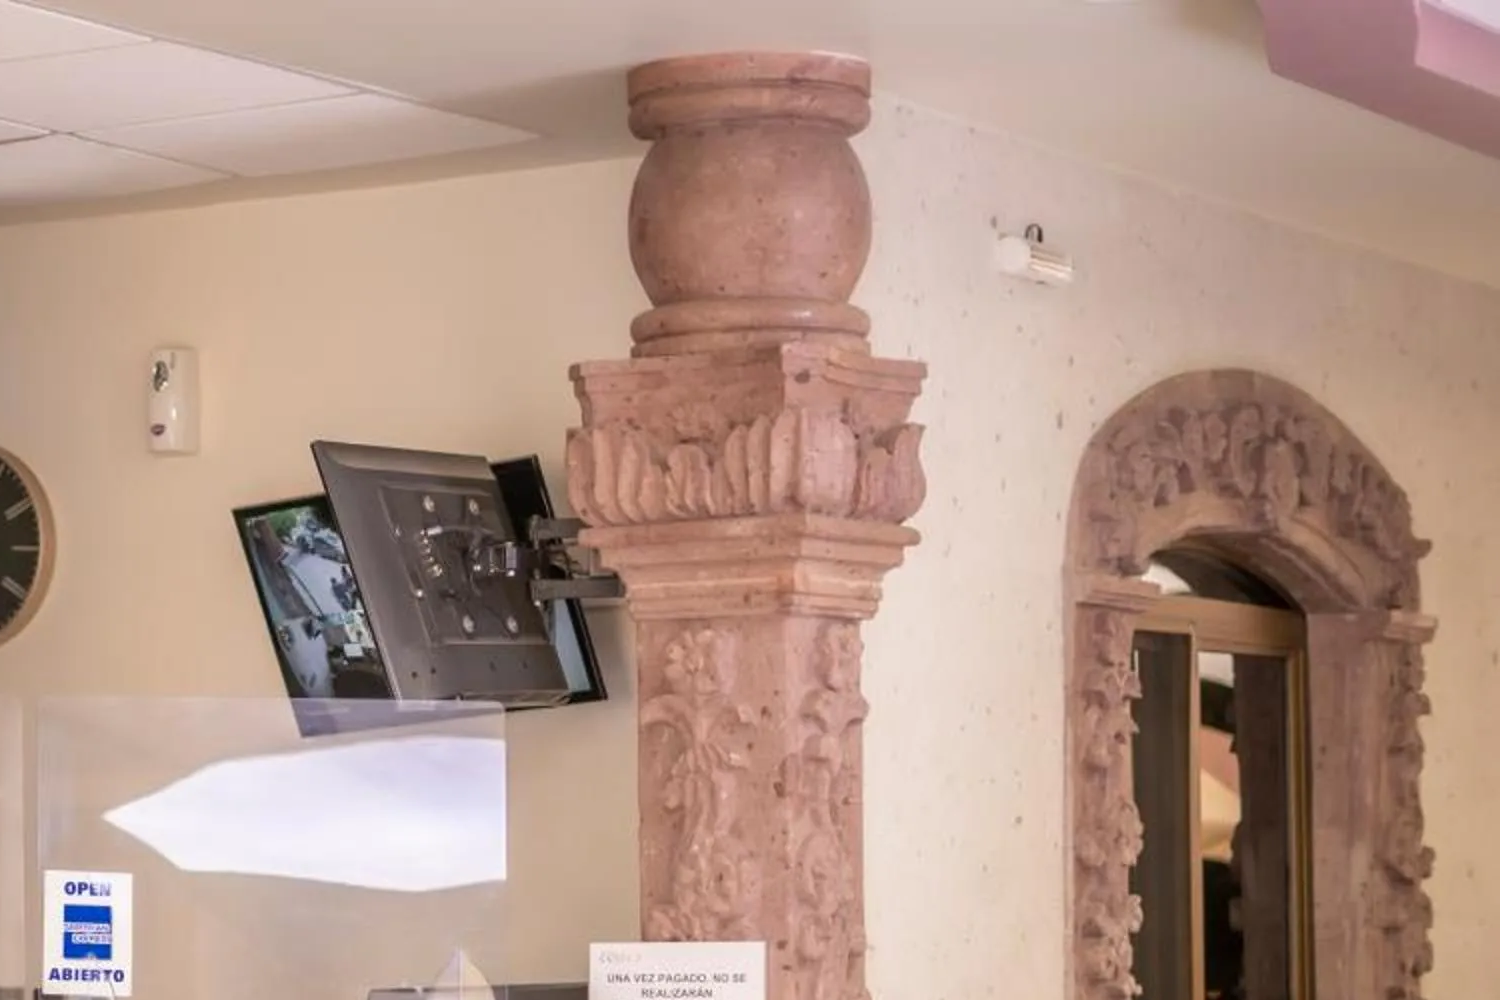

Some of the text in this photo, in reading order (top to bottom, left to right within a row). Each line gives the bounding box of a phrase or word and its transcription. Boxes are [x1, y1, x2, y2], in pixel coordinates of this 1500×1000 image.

[64, 881, 111, 896] OPEN
[49, 967, 124, 982] ABIERTO
[607, 973, 630, 983] UNA
[633, 973, 654, 983] VEZ
[713, 973, 729, 983] NO
[732, 973, 747, 983] SE
